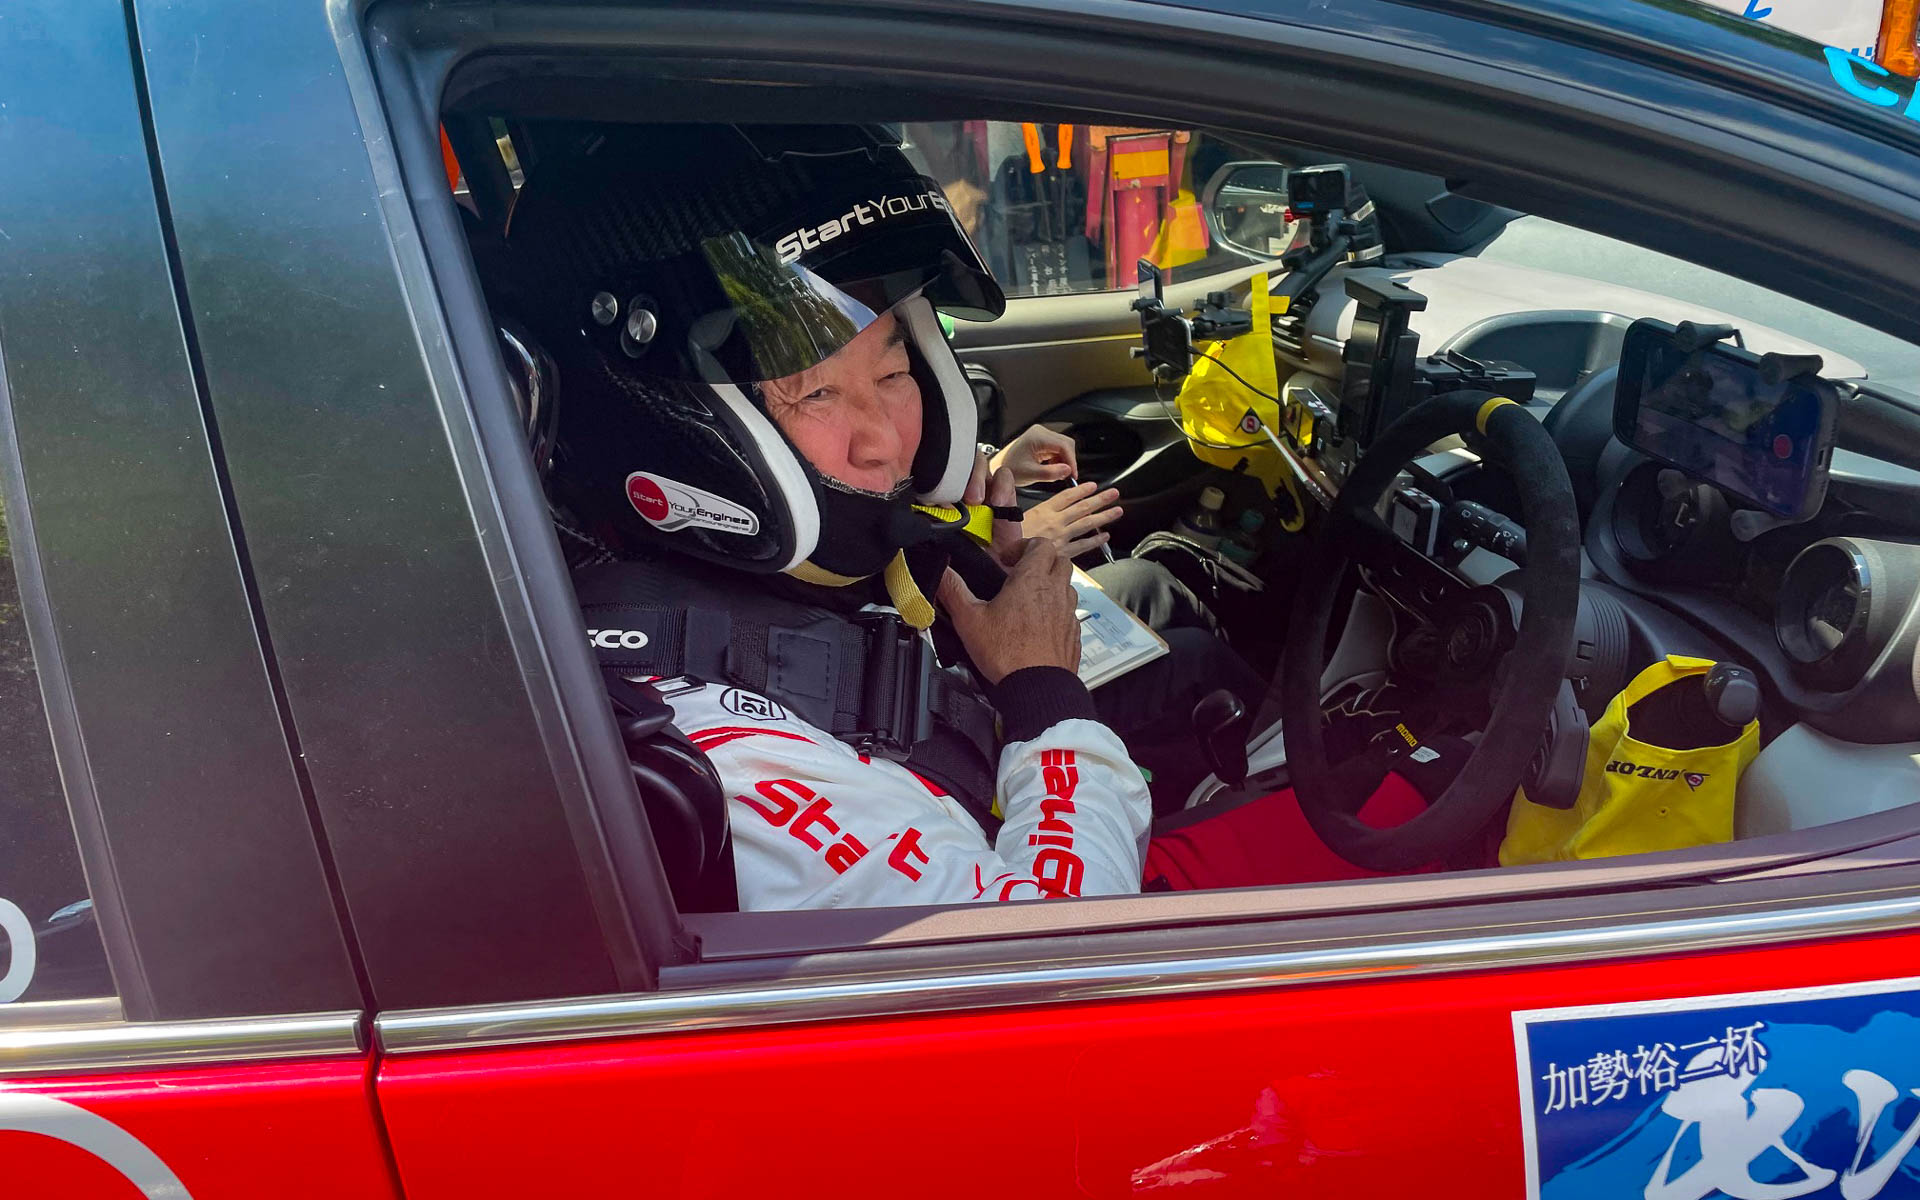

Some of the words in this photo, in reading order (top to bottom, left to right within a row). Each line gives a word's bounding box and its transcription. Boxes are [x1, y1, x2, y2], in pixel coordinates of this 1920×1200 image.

[734, 778, 930, 882] Stat
[1541, 1020, 1768, 1115] 加勢裕二杯
